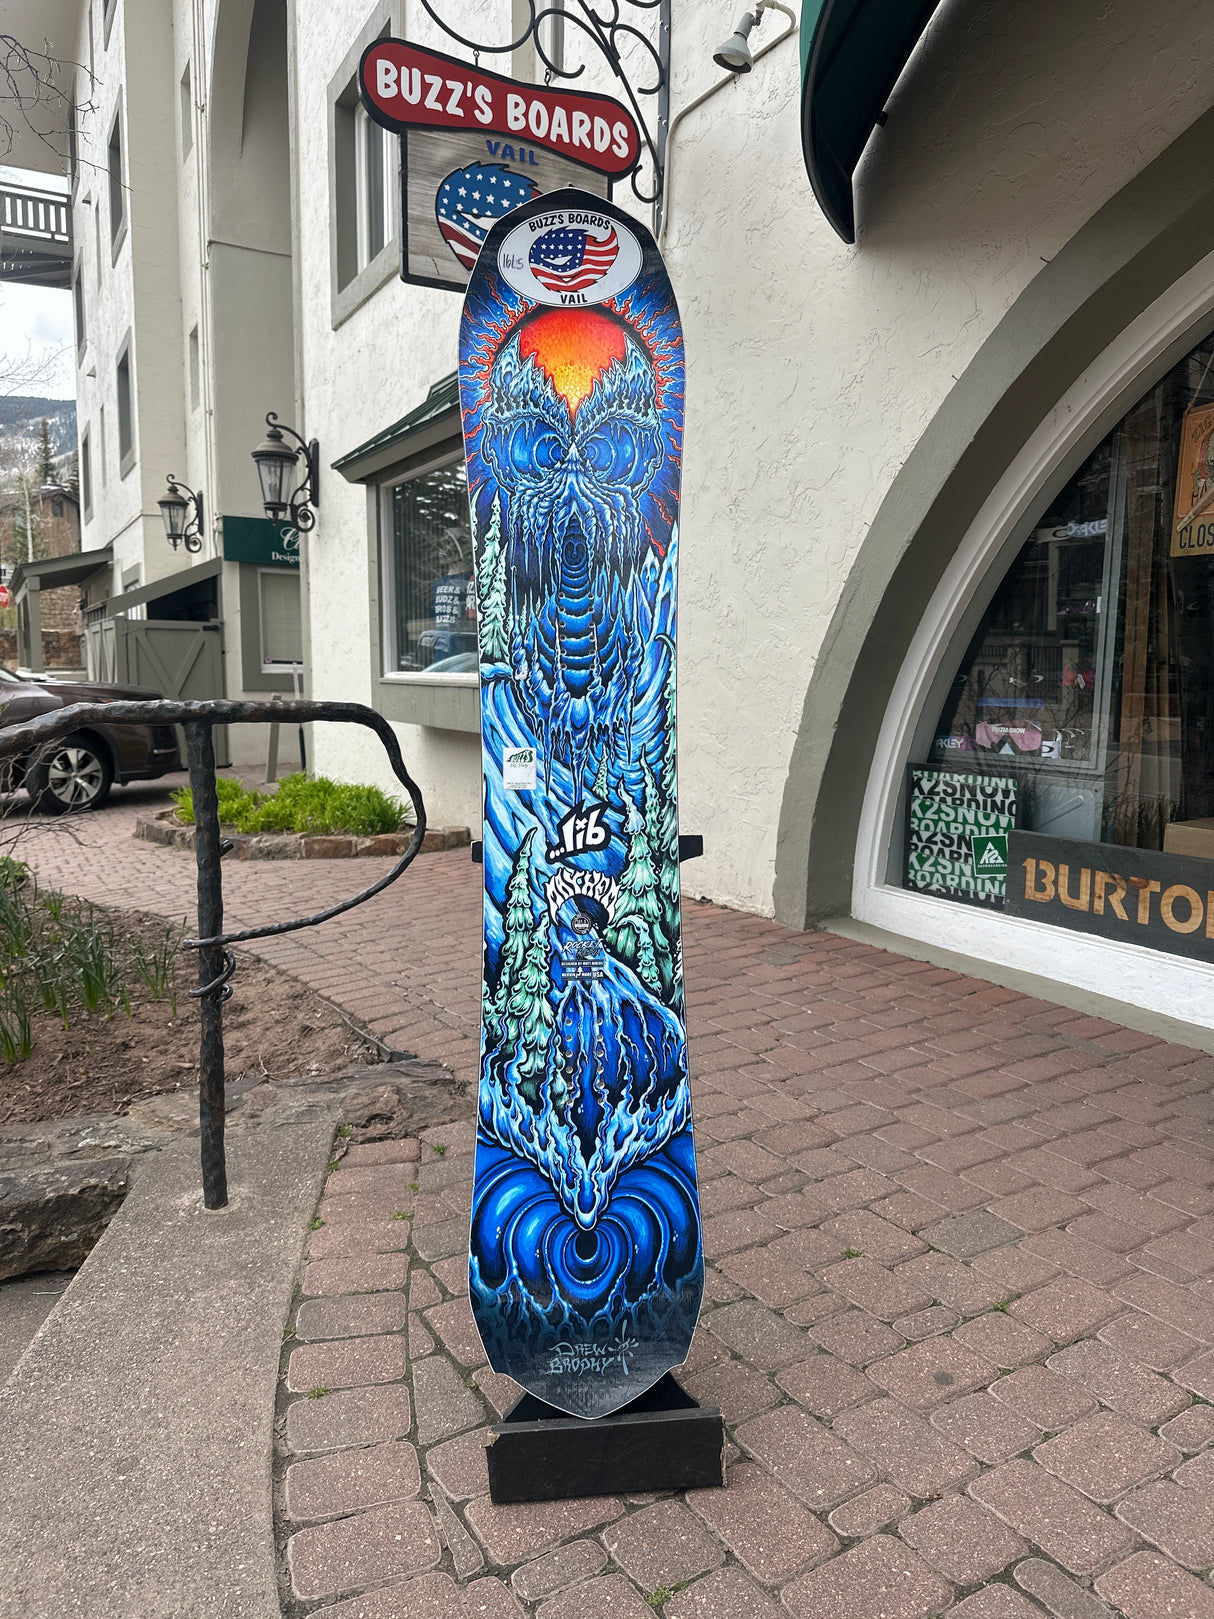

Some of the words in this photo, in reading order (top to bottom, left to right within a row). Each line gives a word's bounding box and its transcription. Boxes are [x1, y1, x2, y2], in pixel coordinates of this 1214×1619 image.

[376, 58, 494, 125] BUZZ'S
[506, 93, 629, 159] BOARDS
[486, 139, 540, 166] VAIL
[528, 213, 564, 232] BUZZ'S
[568, 213, 611, 230] BOARDS
[560, 293, 588, 304] VAIL
[545, 867, 622, 926] MAYHEM
[1022, 857, 1214, 940] BURTO
[561, 938, 604, 955] ROCKET
[592, 970, 604, 978] USA
[547, 1341, 609, 1357] DREW
[545, 1356, 614, 1377] BROPHY
